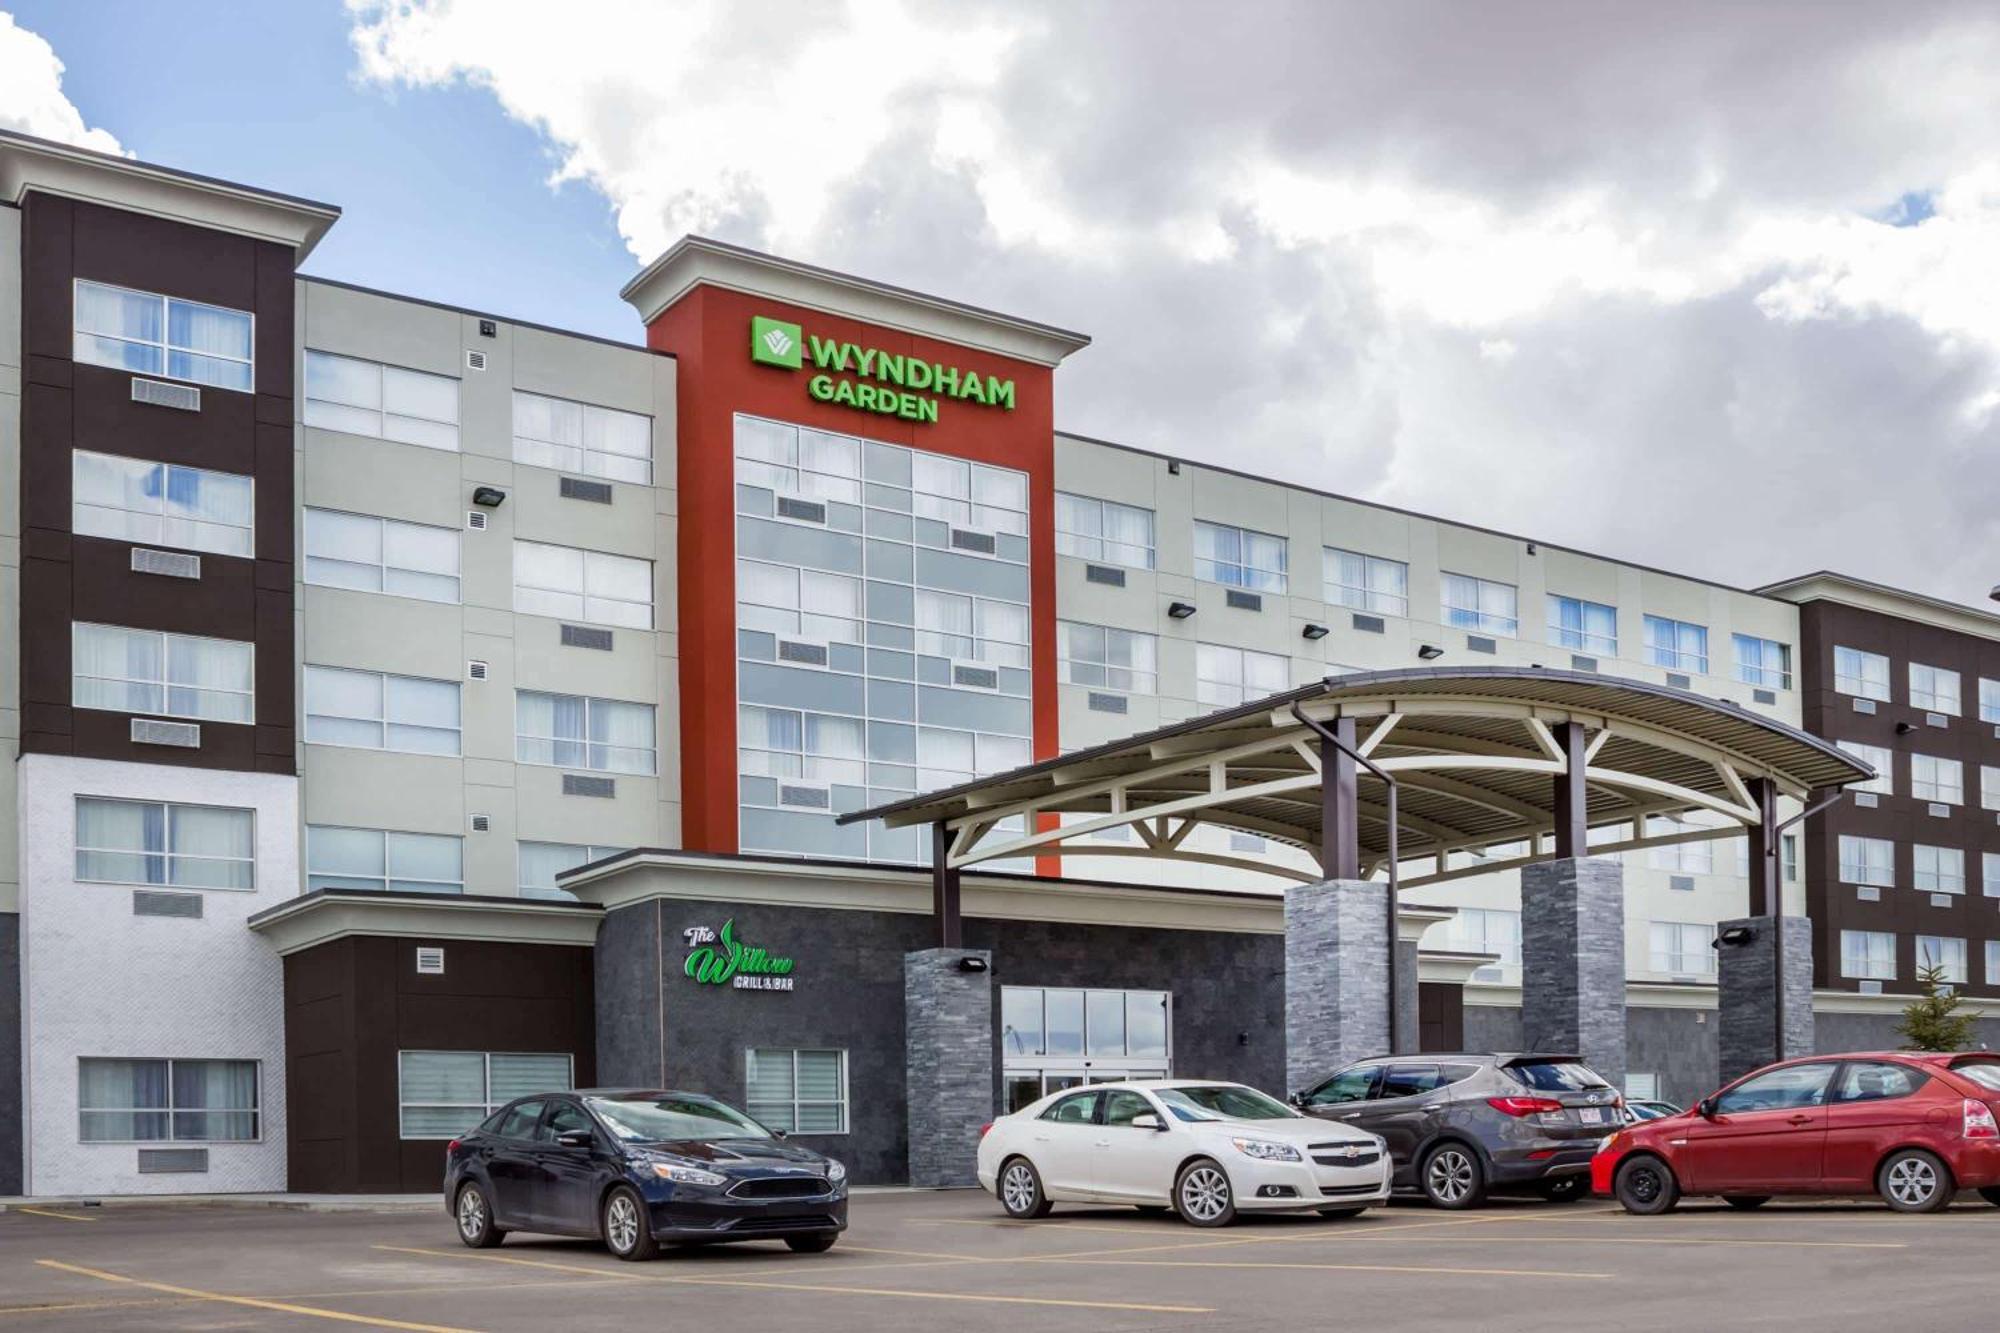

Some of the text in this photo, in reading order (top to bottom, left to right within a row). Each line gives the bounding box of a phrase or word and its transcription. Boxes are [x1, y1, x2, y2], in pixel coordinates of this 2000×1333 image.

[809, 334, 1015, 410] WYNDHAM
[809, 374, 938, 423] GARDEN
[684, 926, 715, 947] The
[684, 919, 793, 984] Willow
